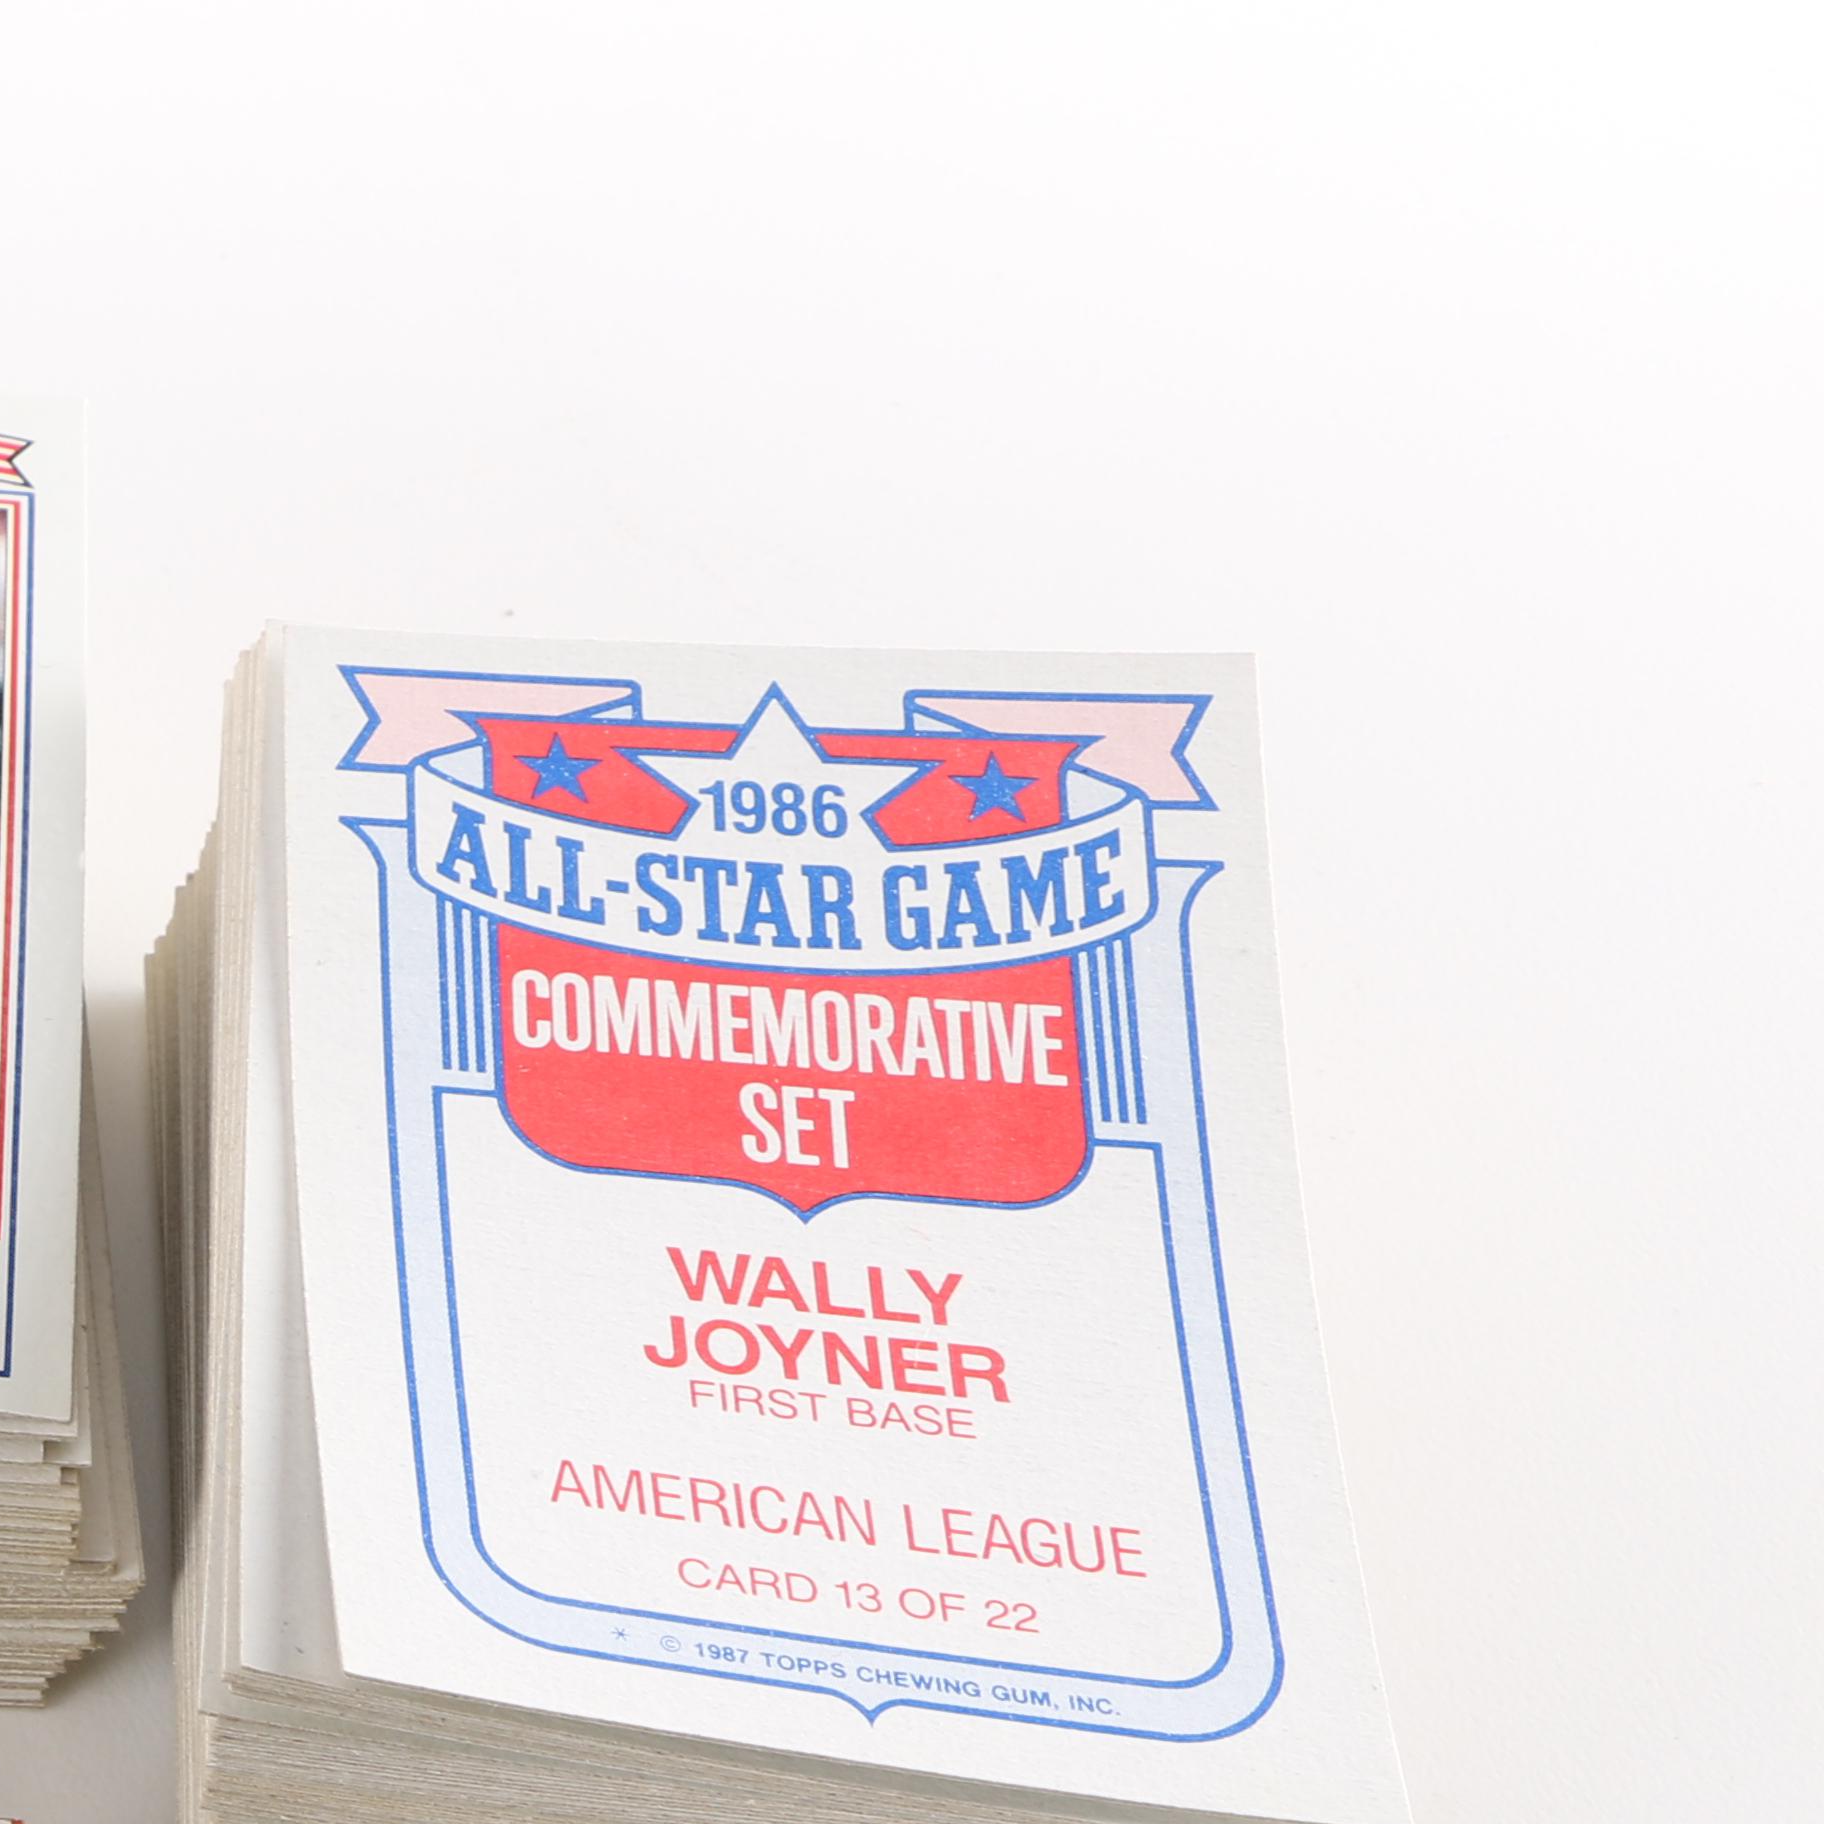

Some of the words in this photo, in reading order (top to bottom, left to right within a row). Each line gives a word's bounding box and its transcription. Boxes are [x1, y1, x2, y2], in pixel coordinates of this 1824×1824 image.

[699, 780, 848, 838] 1986
[436, 800, 863, 951] ALL-STAR
[880, 828, 1126, 951] GAME
[510, 968, 1069, 1087] COMMEMORATIVE
[738, 1082, 855, 1168] SET
[665, 1246, 964, 1326] WALLY
[642, 1314, 1012, 1403] JOYNER
[688, 1379, 827, 1422] FIRST
[846, 1397, 978, 1440] BASE
[550, 1459, 878, 1546] AMERICAN
[903, 1503, 1148, 1578] LEAGUE
[677, 1557, 818, 1603] CARD
[835, 1580, 883, 1613] 13
[898, 1587, 966, 1623] OF
[984, 1599, 1041, 1634] 22
[693, 1641, 751, 1665] 1987
[759, 1651, 848, 1679] TOPPS
[856, 1664, 982, 1699] CHEWING
[991, 1683, 1060, 1711] GUM,
[1068, 1694, 1123, 1717] INC.
